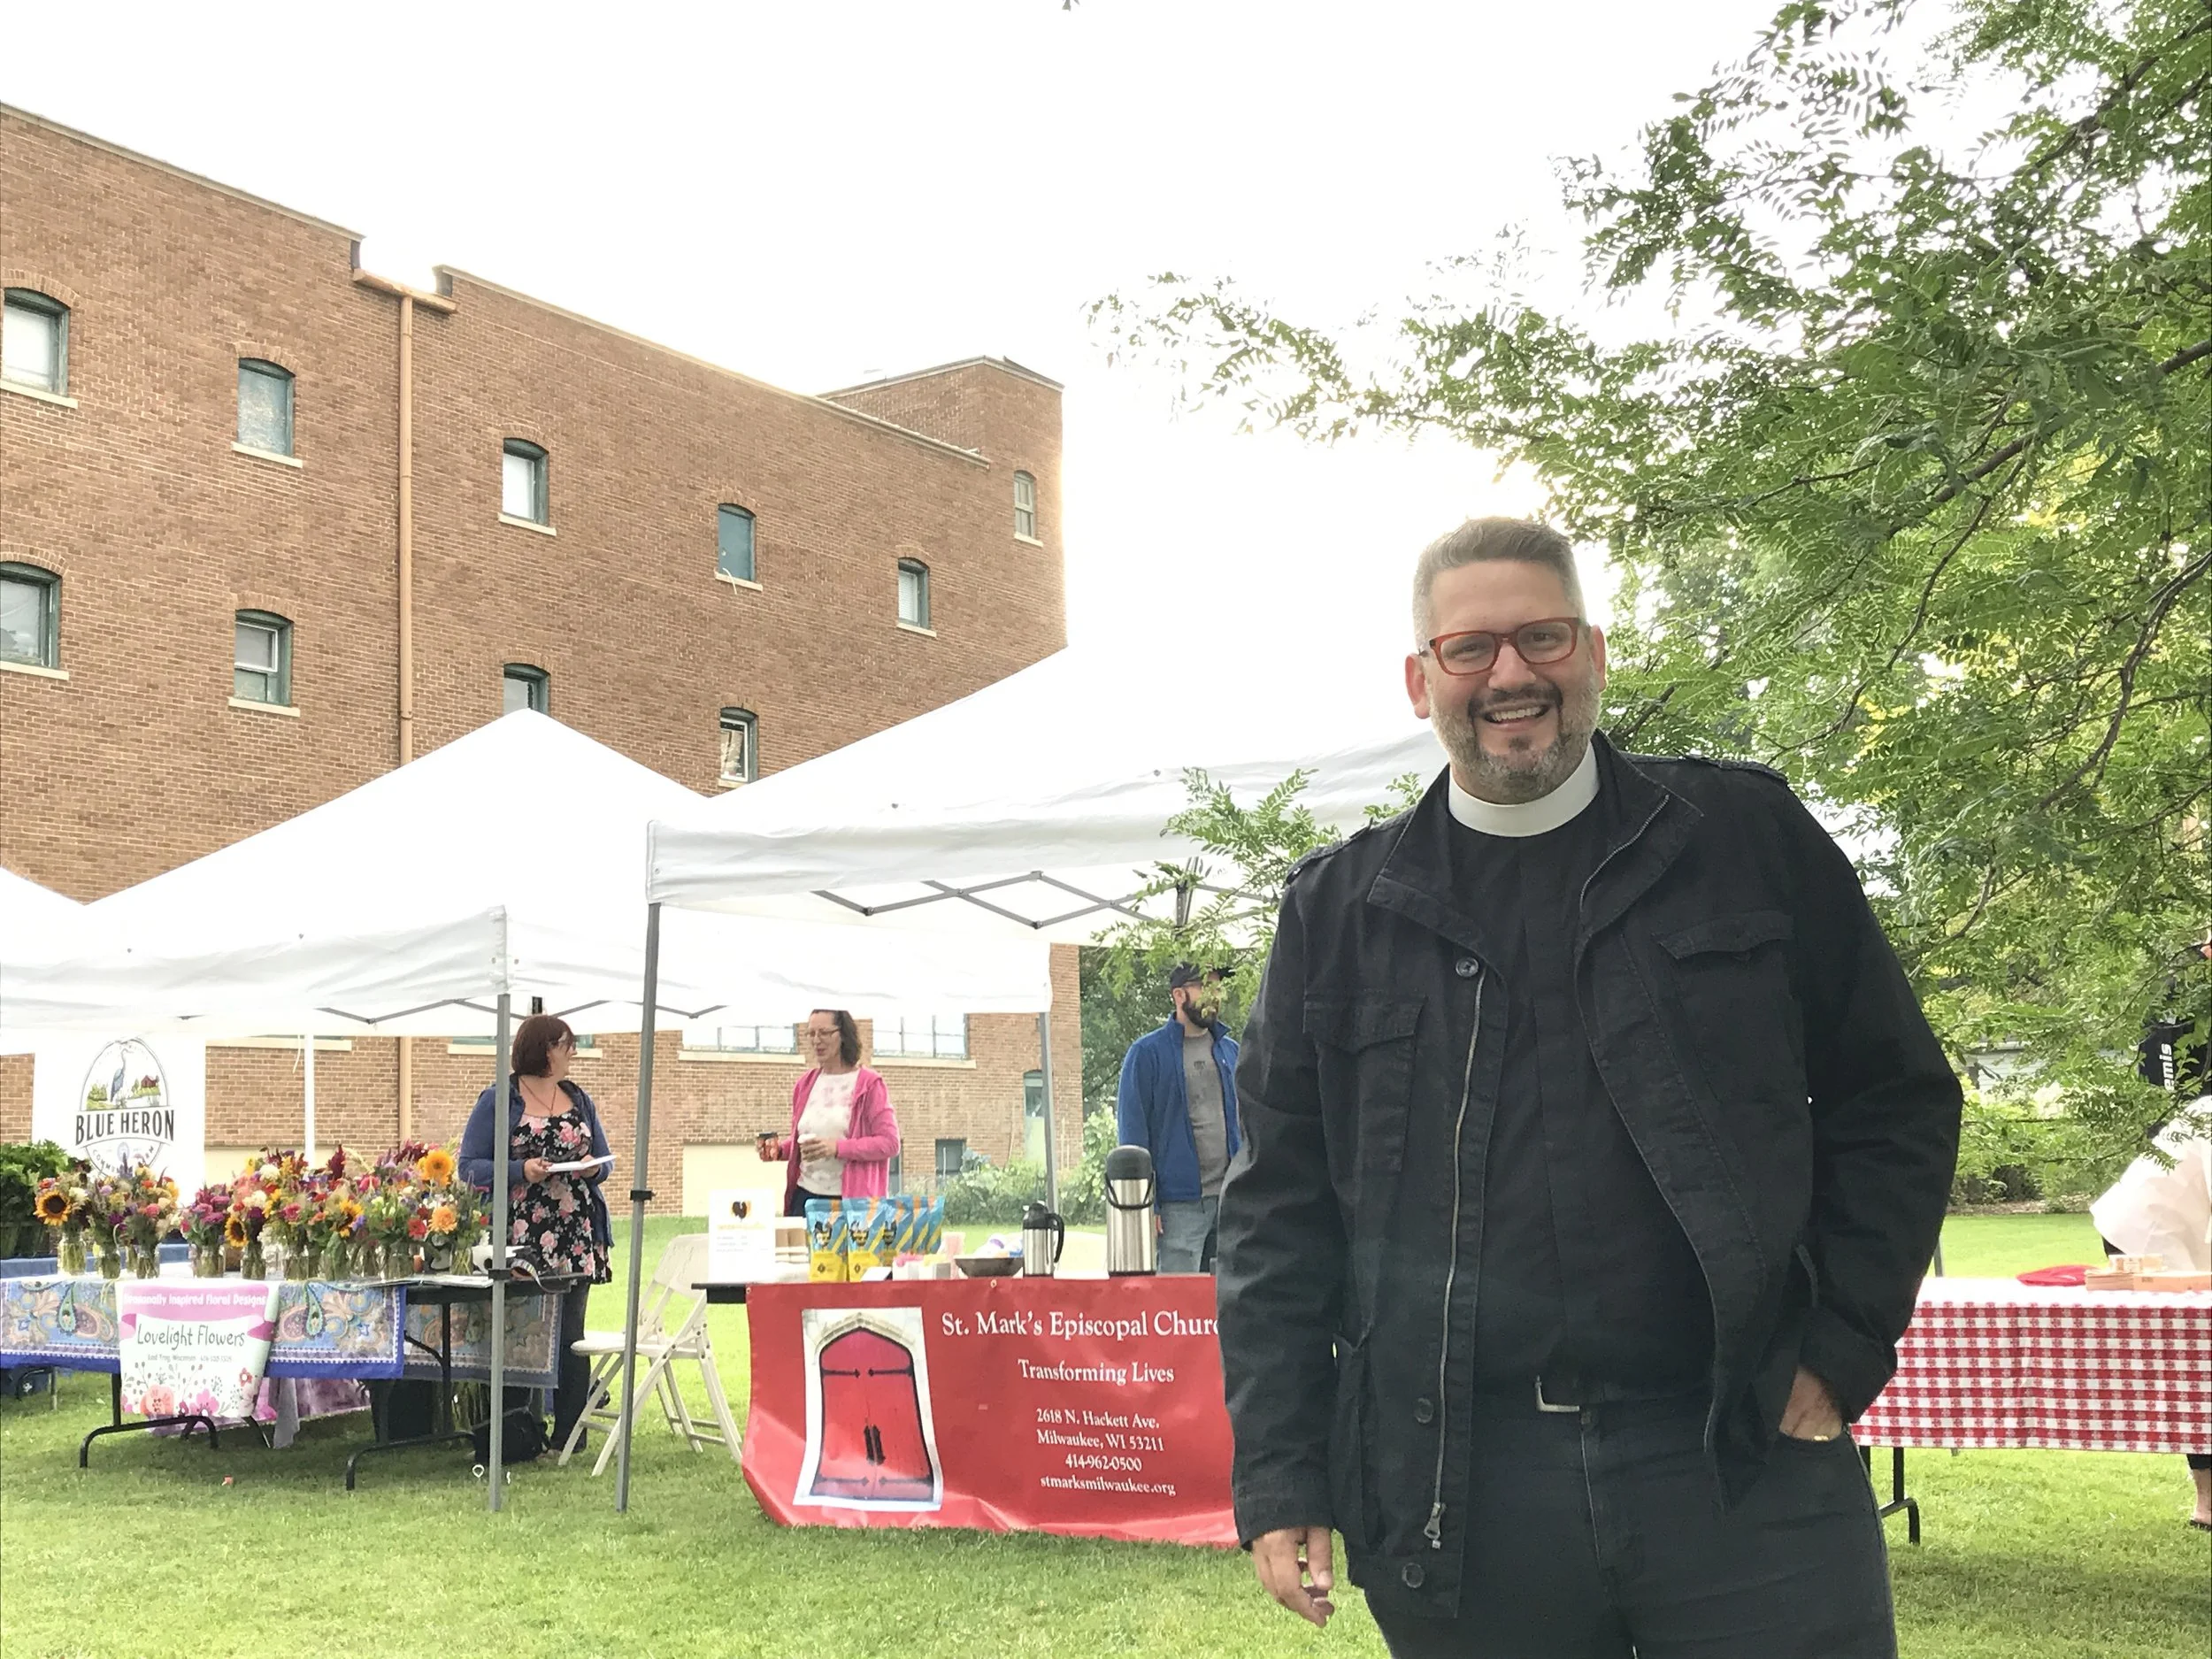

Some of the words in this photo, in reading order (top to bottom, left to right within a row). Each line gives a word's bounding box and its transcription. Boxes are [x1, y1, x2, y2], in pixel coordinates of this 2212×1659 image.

[75, 1113, 114, 1146] BLUE
[120, 1110, 174, 1141] HERON
[168, 1293, 204, 1308] Inspired
[233, 1293, 266, 1309] Designs
[137, 1324, 193, 1350] Lovelight
[197, 1325, 245, 1347] Flowers
[941, 1311, 970, 1336] St.
[975, 1310, 1043, 1336] Mark's
[1049, 1310, 1148, 1341] Episcopal
[1018, 1358, 1127, 1386] Transforming
[1132, 1362, 1175, 1383] Lives
[1036, 1408, 1062, 1424] 2618
[1064, 1409, 1080, 1425] N.
[1082, 1409, 1129, 1428] Hackett
[1132, 1412, 1160, 1429] Ave.
[1036, 1428, 1104, 1449] Milwaukee,
[1105, 1433, 1126, 1449] WI
[1129, 1435, 1165, 1452] 53211
[1064, 1453, 1142, 1472] 414-962-0500
[1040, 1474, 1177, 1497] stmarksmilwaukee.org
